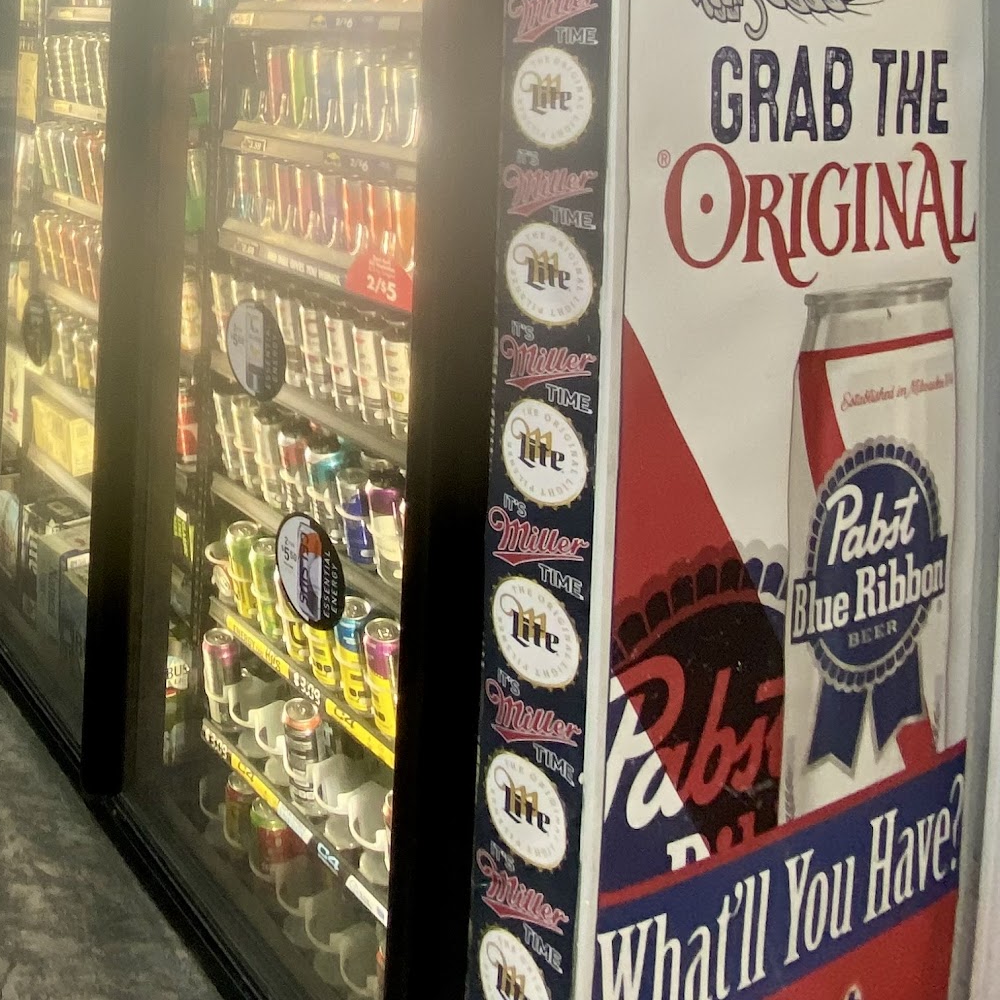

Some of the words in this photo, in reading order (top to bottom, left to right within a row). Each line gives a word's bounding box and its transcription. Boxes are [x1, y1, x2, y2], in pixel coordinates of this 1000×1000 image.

[555, 27, 599, 46] TIME
[529, 83, 572, 115] Lite
[710, 45, 853, 144] GRAB
[872, 48, 948, 135] THE
[517, 148, 540, 166] IT'S
[503, 163, 599, 217] Miller
[550, 205, 596, 231] TIME
[664, 142, 976, 288] ORIGINAL
[366, 274, 397, 301] 2/$5
[524, 256, 571, 291] Lite
[511, 320, 535, 341] IT'S
[500, 334, 597, 391] Miller
[545, 383, 593, 415] TIME
[518, 431, 565, 471] Lite
[503, 492, 527, 518] IT'S
[826, 483, 919, 565] Pabst
[488, 505, 590, 566] Miller
[322, 550, 331, 619] ESSENTIAL
[331, 563, 339, 614] ENERGY
[538, 563, 584, 600] TIME
[792, 580, 849, 638] Blue
[854, 552, 944, 622] Ribbon
[510, 609, 560, 654] Lite
[848, 619, 898, 648] BEER
[497, 667, 521, 697] IT'S
[485, 677, 583, 747] Miller
[532, 742, 575, 787] TIME
[503, 783, 550, 834] Lite
[317, 842, 341, 872] C4
[490, 840, 516, 872] IT'S
[476, 848, 570, 935] Miller
[597, 868, 771, 1000] What'll
[783, 849, 856, 966] You
[862, 772, 964, 924] Have?
[522, 921, 564, 974] TIME
